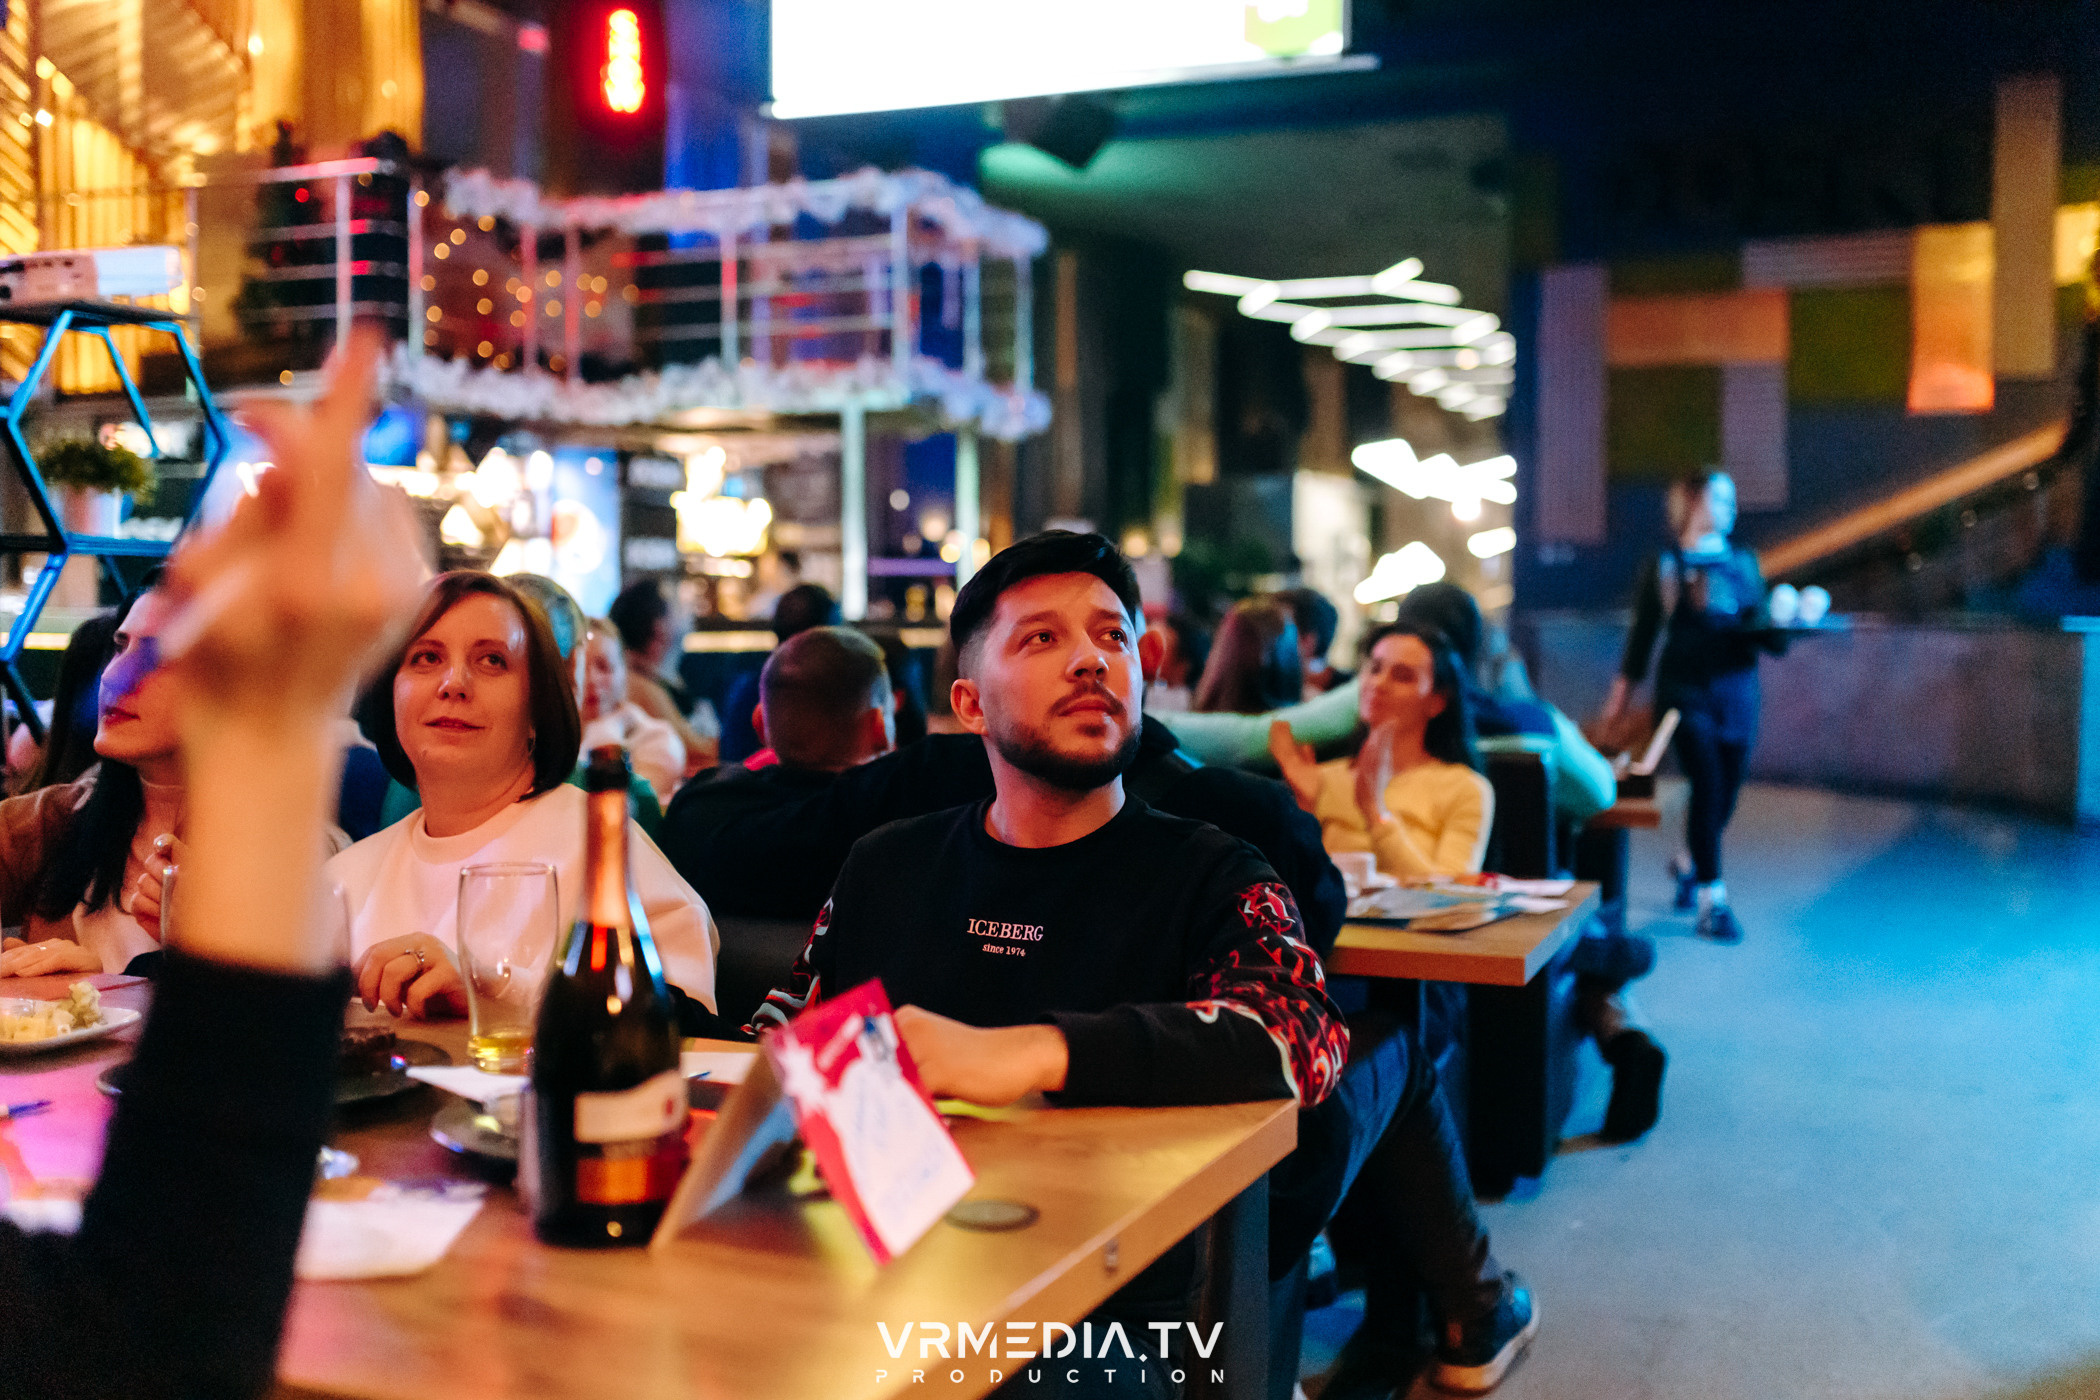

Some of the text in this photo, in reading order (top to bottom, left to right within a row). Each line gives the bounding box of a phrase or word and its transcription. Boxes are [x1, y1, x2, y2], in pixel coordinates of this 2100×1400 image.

[966, 918, 1044, 942] ICEBERG
[982, 943, 1026, 957] since 1974
